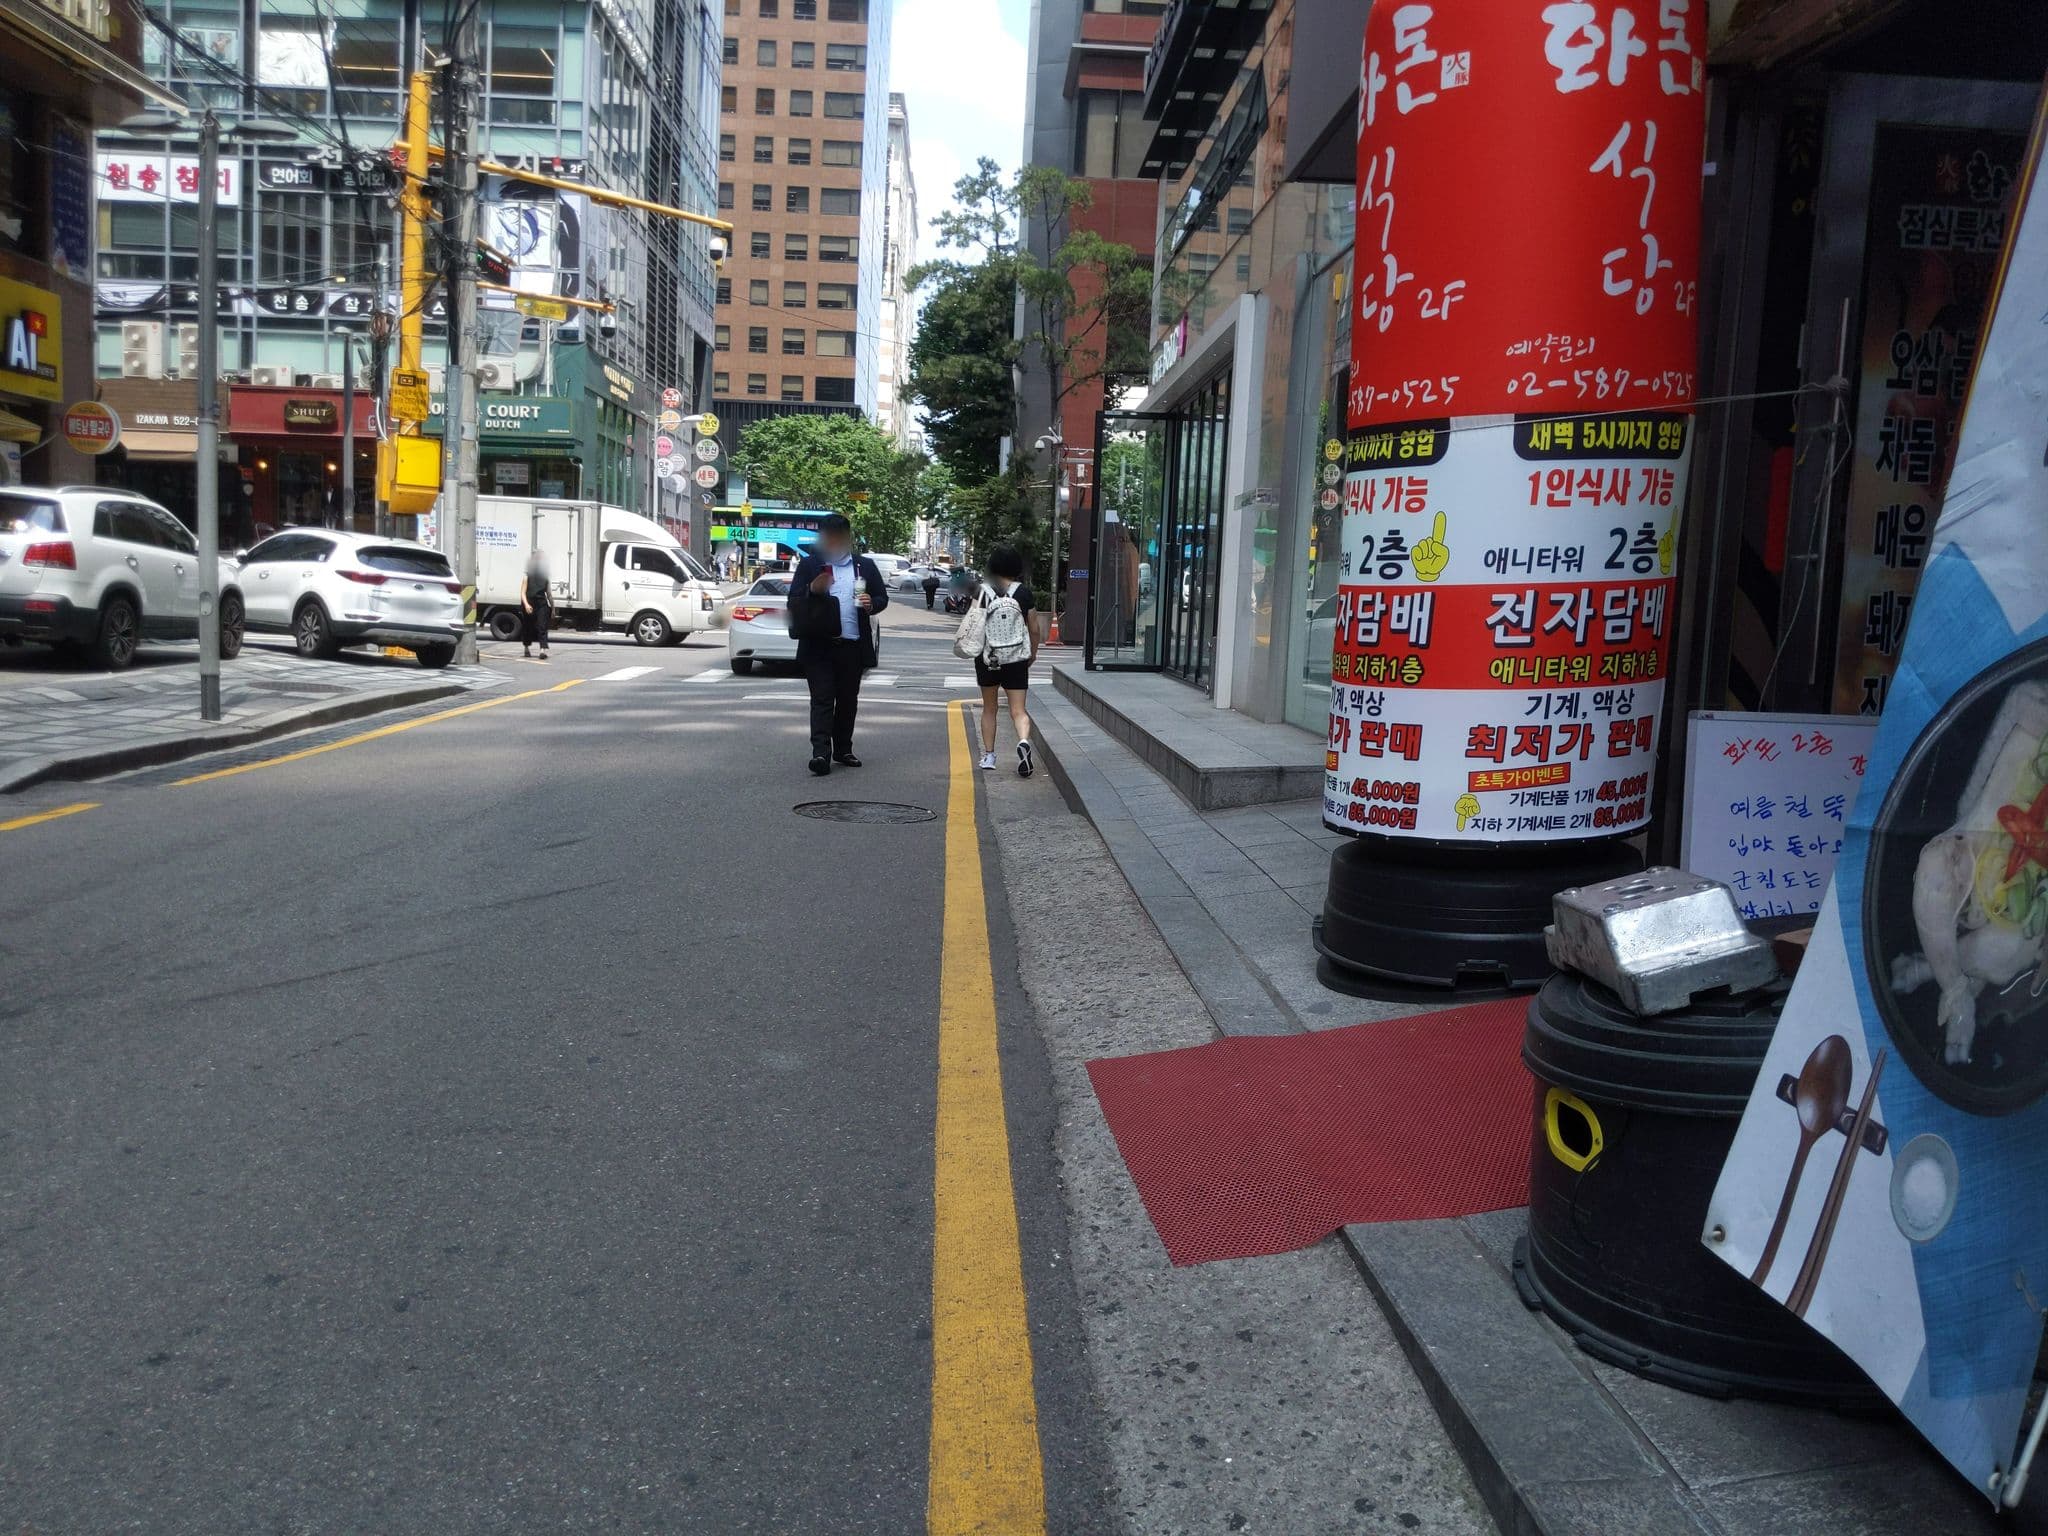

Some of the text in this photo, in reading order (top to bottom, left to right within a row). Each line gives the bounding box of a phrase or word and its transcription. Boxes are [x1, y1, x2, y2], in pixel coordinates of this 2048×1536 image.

[1542, 0, 1690, 95] 화돈
[271, 167, 313, 184] 연어회
[570, 164, 584, 174] 2F
[1418, 280, 1466, 320] 2F
[1506, 333, 1595, 364] 예약문의
[1507, 366, 1694, 400] 02-587-0525
[485, 419, 521, 429] DUTCH
[487, 405, 541, 418] COURT
[1399, 429, 1435, 459] 영업
[1528, 420, 1576, 452] 새벽
[1583, 420, 1653, 450] 5시까지
[698, 470, 716, 481] 세탁
[1527, 467, 1676, 508] 1인식사 가능
[1382, 476, 1429, 513] 가능
[1483, 522, 1659, 575] 애니타워 2층
[1873, 504, 1927, 569] 매운
[1359, 529, 1410, 580] 2층
[1486, 584, 1667, 647] 전자담배
[1355, 654, 1425, 685] 지하1층
[1490, 650, 1659, 685] 애니타워 지하1층
[1359, 720, 1423, 762] 판매
[1465, 715, 1654, 762] 최저가 판매
[1791, 730, 1834, 755] 2층
[1351, 777, 1421, 805] 45,000원
[1475, 765, 1565, 788] 초특가이벤트
[1509, 790, 1570, 807] 기계단품
[1575, 788, 1595, 804] 1개
[1347, 801, 1418, 830] 85,000원
[1470, 817, 1503, 832] 지하
[1506, 816, 1567, 832] 기계세트
[1570, 814, 1592, 830] 2개
